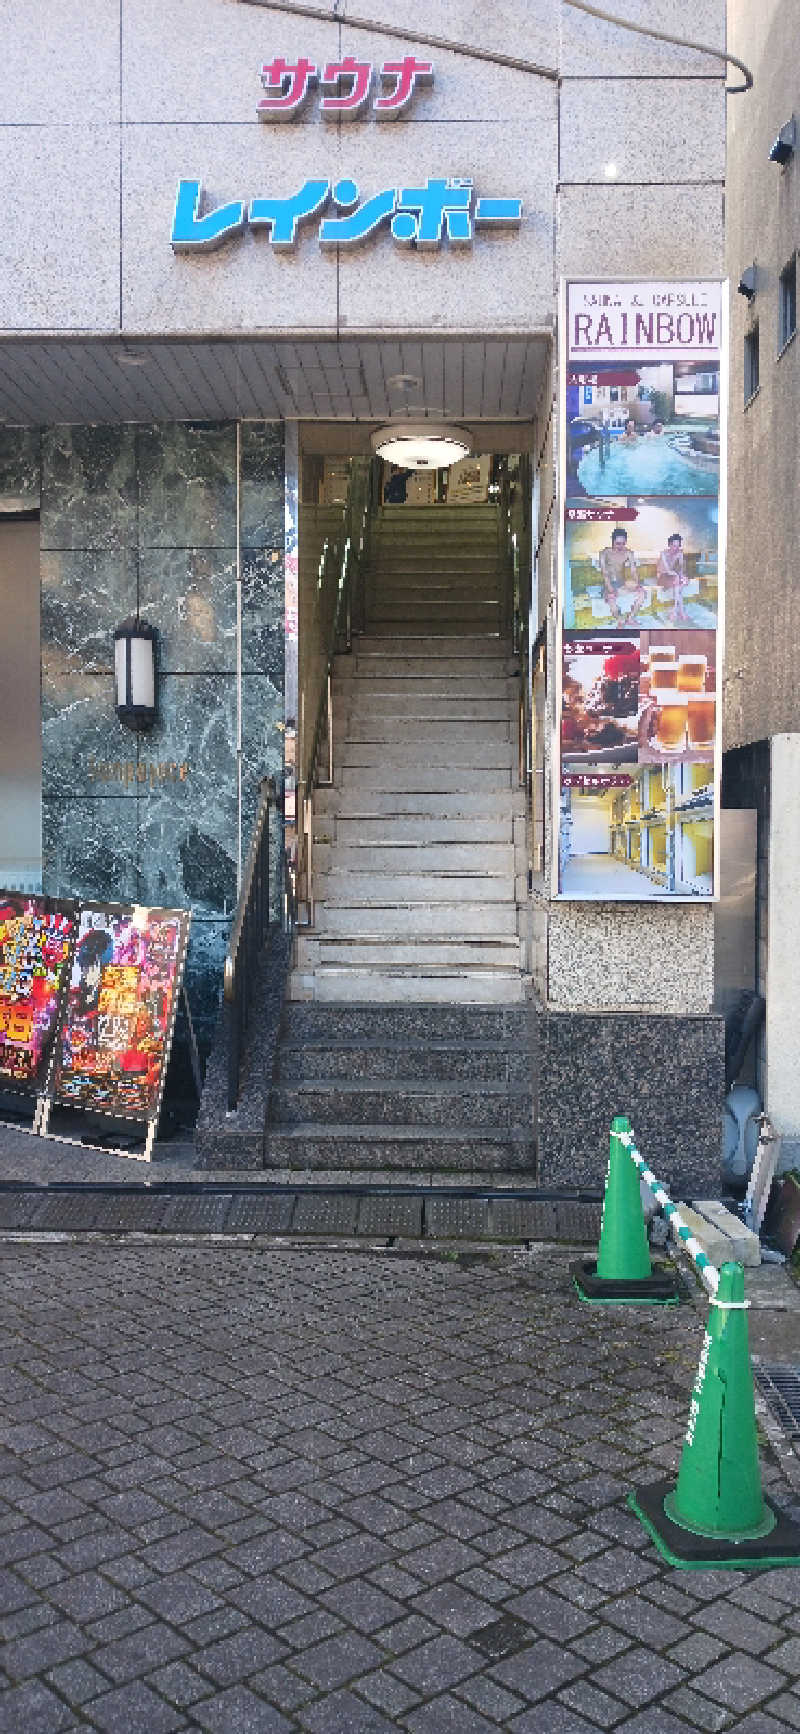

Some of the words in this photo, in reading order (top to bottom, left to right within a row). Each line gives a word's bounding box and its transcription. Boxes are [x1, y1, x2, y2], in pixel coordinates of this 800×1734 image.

[256, 56, 434, 116] サウナ
[171, 178, 522, 246] レインボー
[574, 312, 717, 345] RAINBOW
